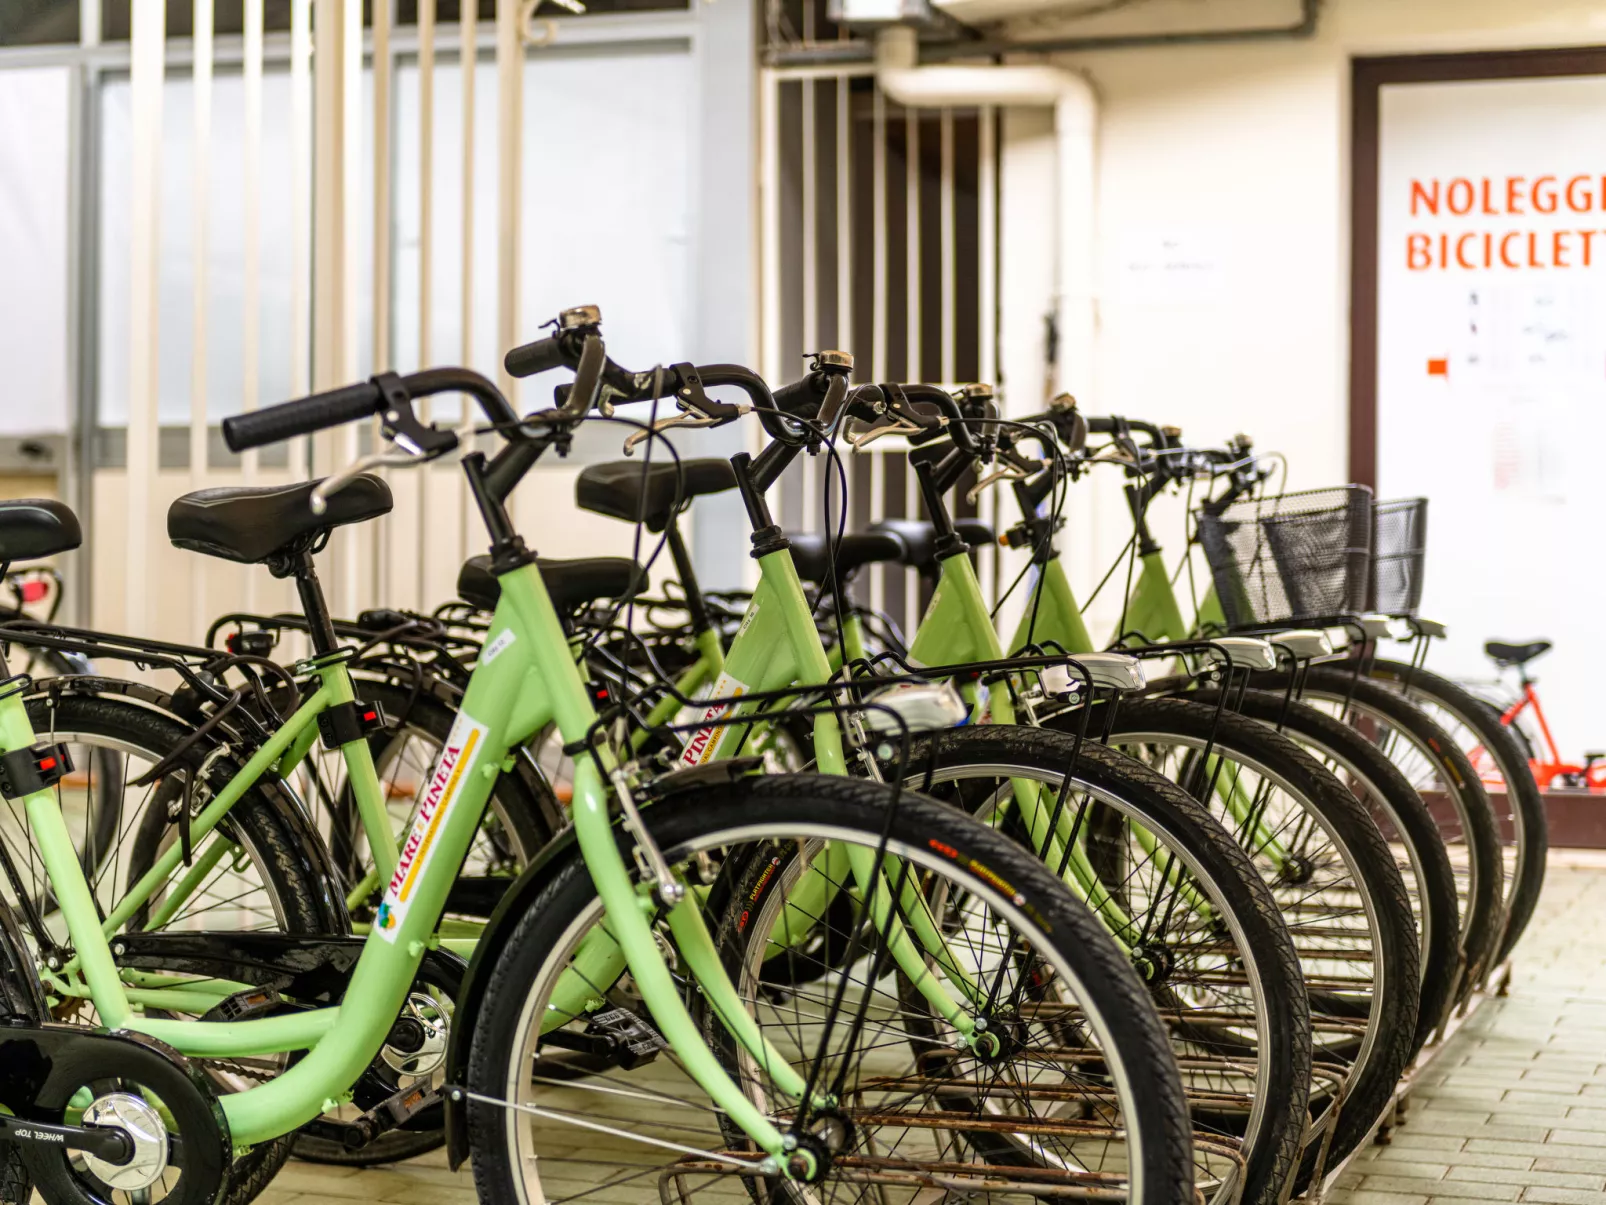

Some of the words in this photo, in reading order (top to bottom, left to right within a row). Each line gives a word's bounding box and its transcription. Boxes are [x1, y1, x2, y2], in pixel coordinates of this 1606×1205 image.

[1409, 174, 1606, 216] NOLEGGI
[1405, 230, 1606, 270] BICICLET
[389, 830, 422, 897] MARE
[419, 745, 460, 822] PINETA
[14, 1129, 32, 1138] TOP
[34, 1131, 64, 1142] WHEEL
